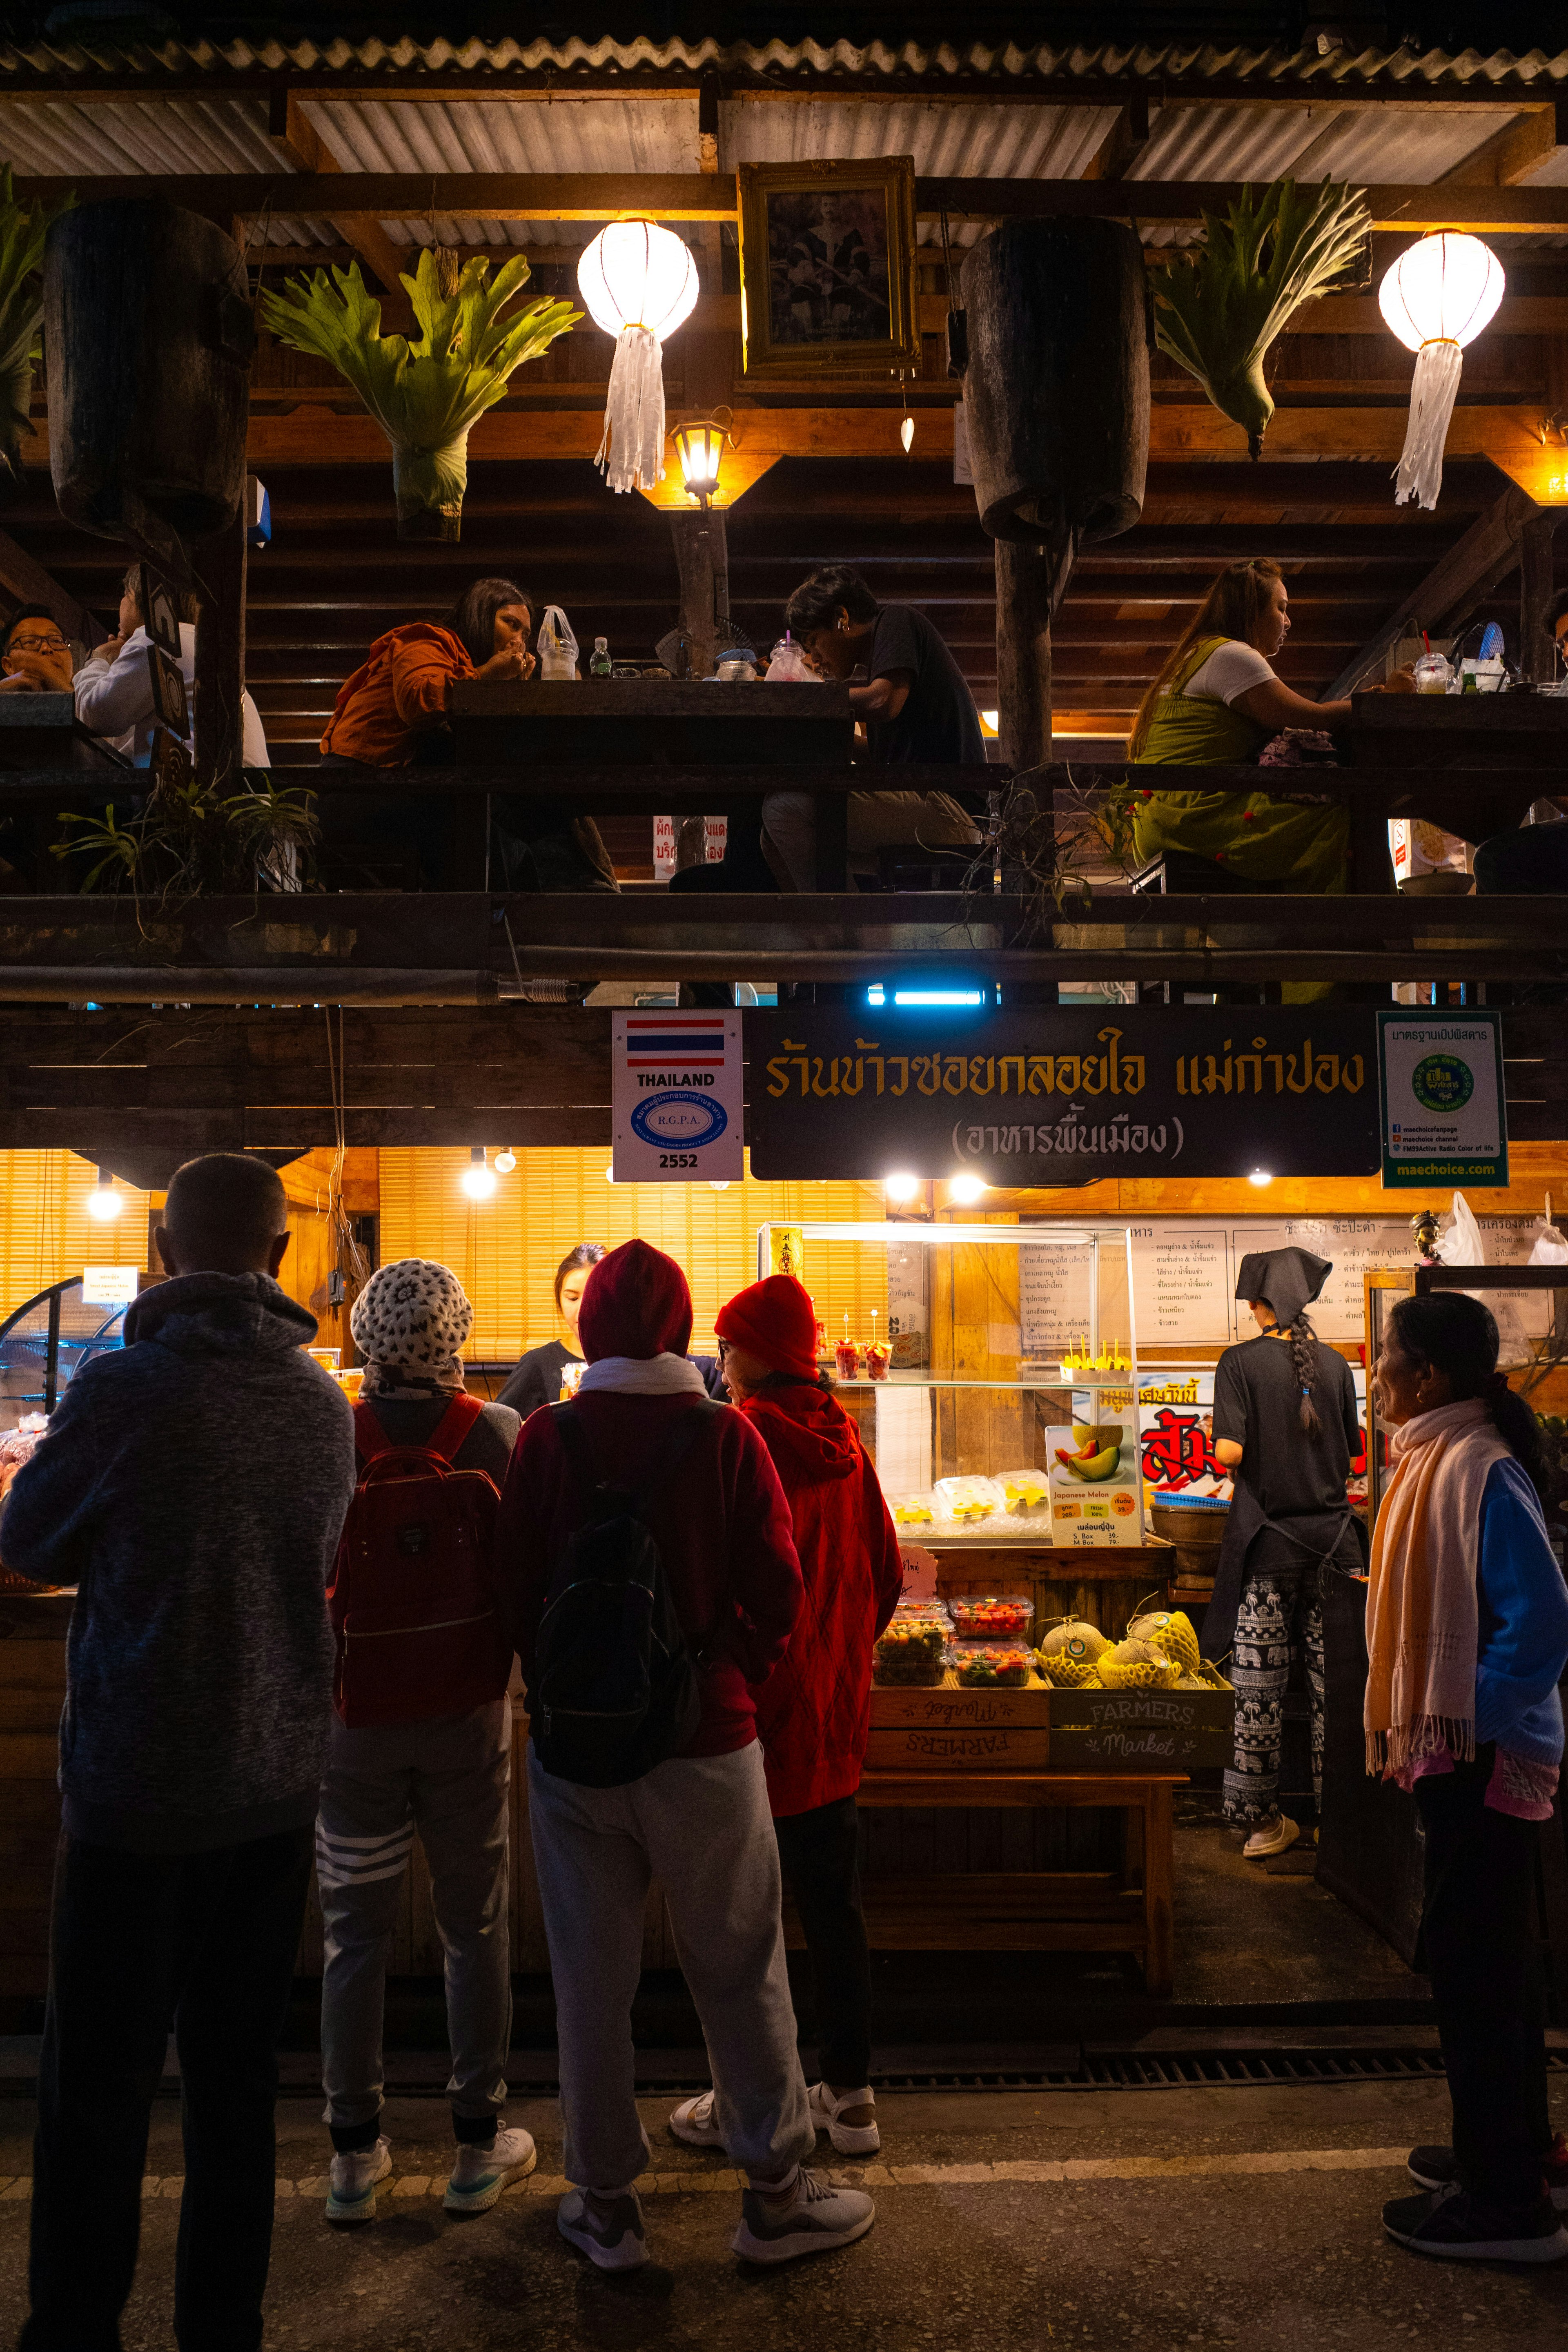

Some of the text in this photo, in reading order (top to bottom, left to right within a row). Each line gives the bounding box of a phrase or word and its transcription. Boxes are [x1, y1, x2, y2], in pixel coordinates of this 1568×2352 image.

[766, 1026, 1364, 1097] ร้านข้าวซอยกลอยใจ แม่กำปอง
[637, 1073, 715, 1086] THAILAND
[637, 1092, 722, 1120] สมาคมผู้ประกอบการร้านอาหาร
[658, 1116, 700, 1125] R.G.P.A.
[635, 1123, 657, 1144] RESTAURANT
[702, 1123, 723, 1144] ASSOCIATION
[952, 1102, 1184, 1163] (อาหารพื้นเมือง)
[659, 1154, 698, 1168] 2552
[1397, 1163, 1495, 1175] maechoice.com
[1388, 1247, 1411, 1258] ปูปลาร้า
[1077, 1521, 1115, 1531] เมล่อนญี่ปุ่น
[925, 1699, 997, 1725] Market
[1090, 1700, 1195, 1725] FARMERS
[905, 1733, 1011, 1757] FARMERS
[1103, 1733, 1176, 1757] Market
